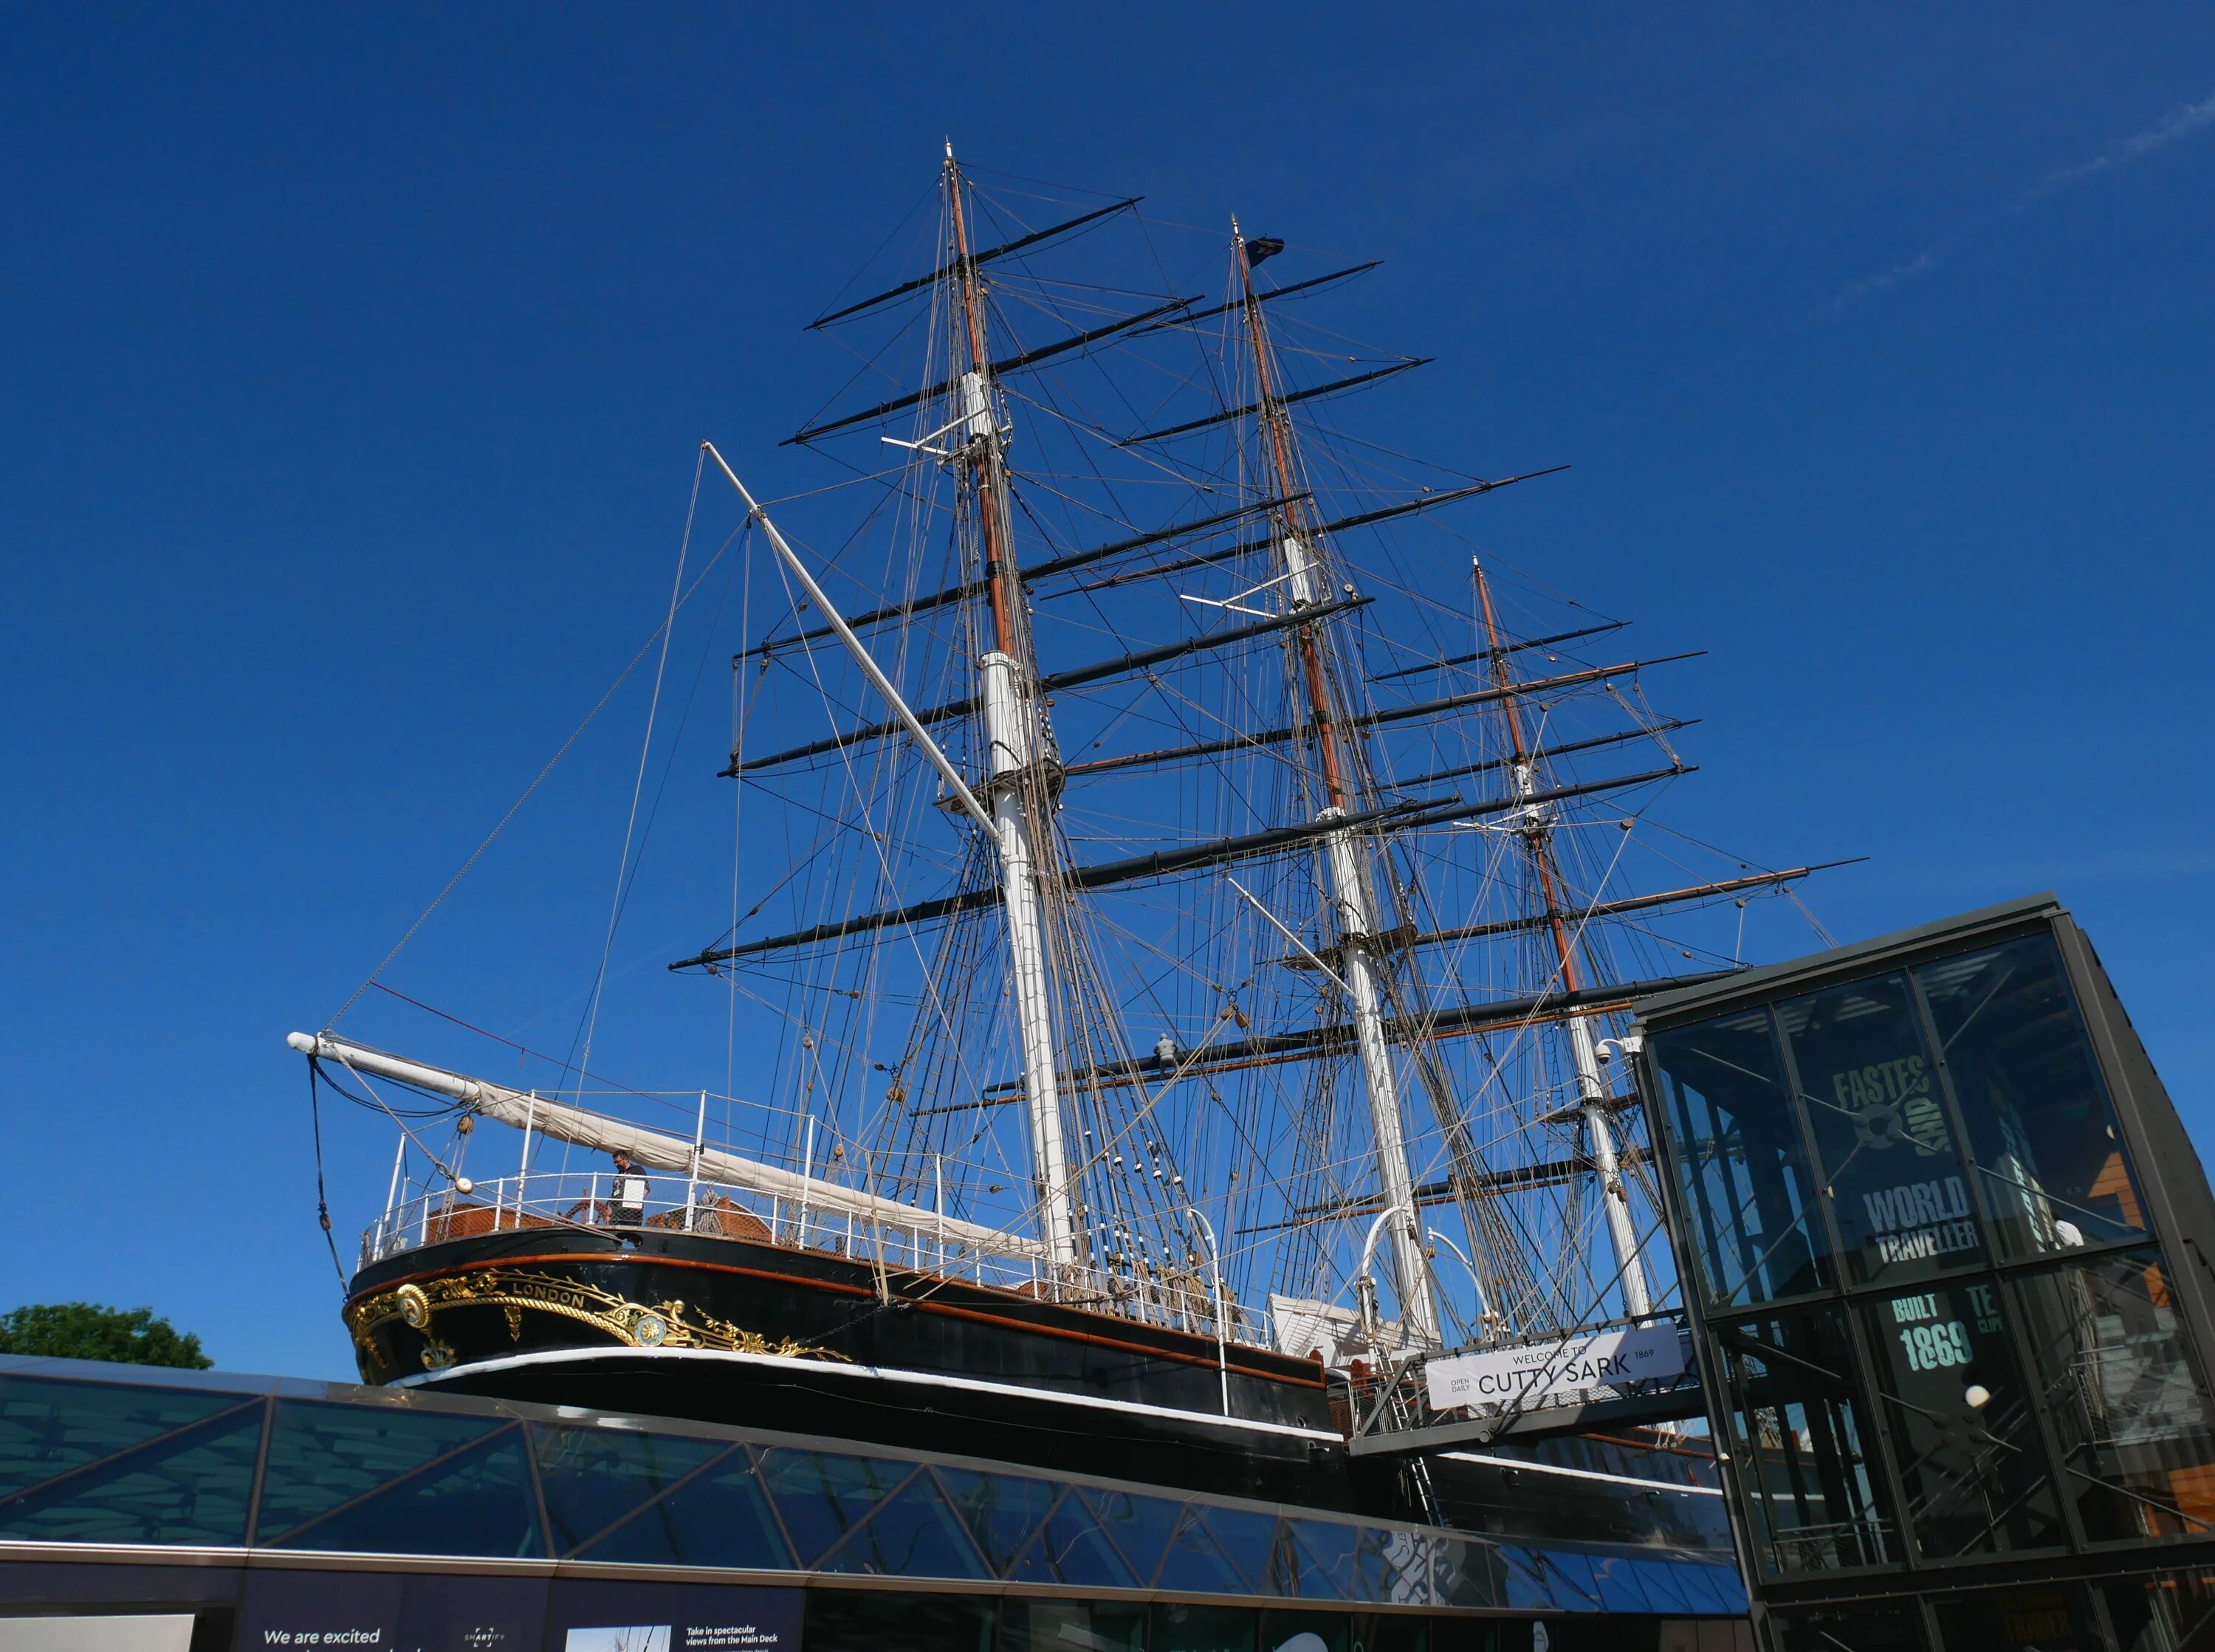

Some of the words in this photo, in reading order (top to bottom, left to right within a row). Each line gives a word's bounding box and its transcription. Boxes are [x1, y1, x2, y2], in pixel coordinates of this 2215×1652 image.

[1904, 1097, 1952, 1157] SHIP
[1863, 1176, 1970, 1233] WORLD
[1875, 1221, 1979, 1264] TRAVELLER
[512, 1282, 585, 1308] LONDON
[1892, 1293, 1938, 1323] BUILT
[1513, 1350, 1569, 1366] WELCOME
[1574, 1346, 1587, 1355] TO
[1635, 1349, 1654, 1359] 1869
[1900, 1321, 1974, 1371] 1869
[1451, 1378, 1469, 1386] OPEN
[1478, 1366, 1557, 1394] CUTTY
[1566, 1353, 1631, 1383] SARK
[1452, 1384, 1470, 1393] DAILY
[264, 1630, 291, 1644] We
[295, 1633, 319, 1644] are
[323, 1628, 380, 1644] excited
[686, 1635, 707, 1645] views
[709, 1635, 726, 1645] from
[728, 1634, 739, 1644] the
[741, 1634, 758, 1643] Main
[759, 1633, 777, 1642] Deck
[687, 1626, 704, 1636] Take
[705, 1625, 712, 1635] in
[714, 1624, 756, 1636] spectacular
